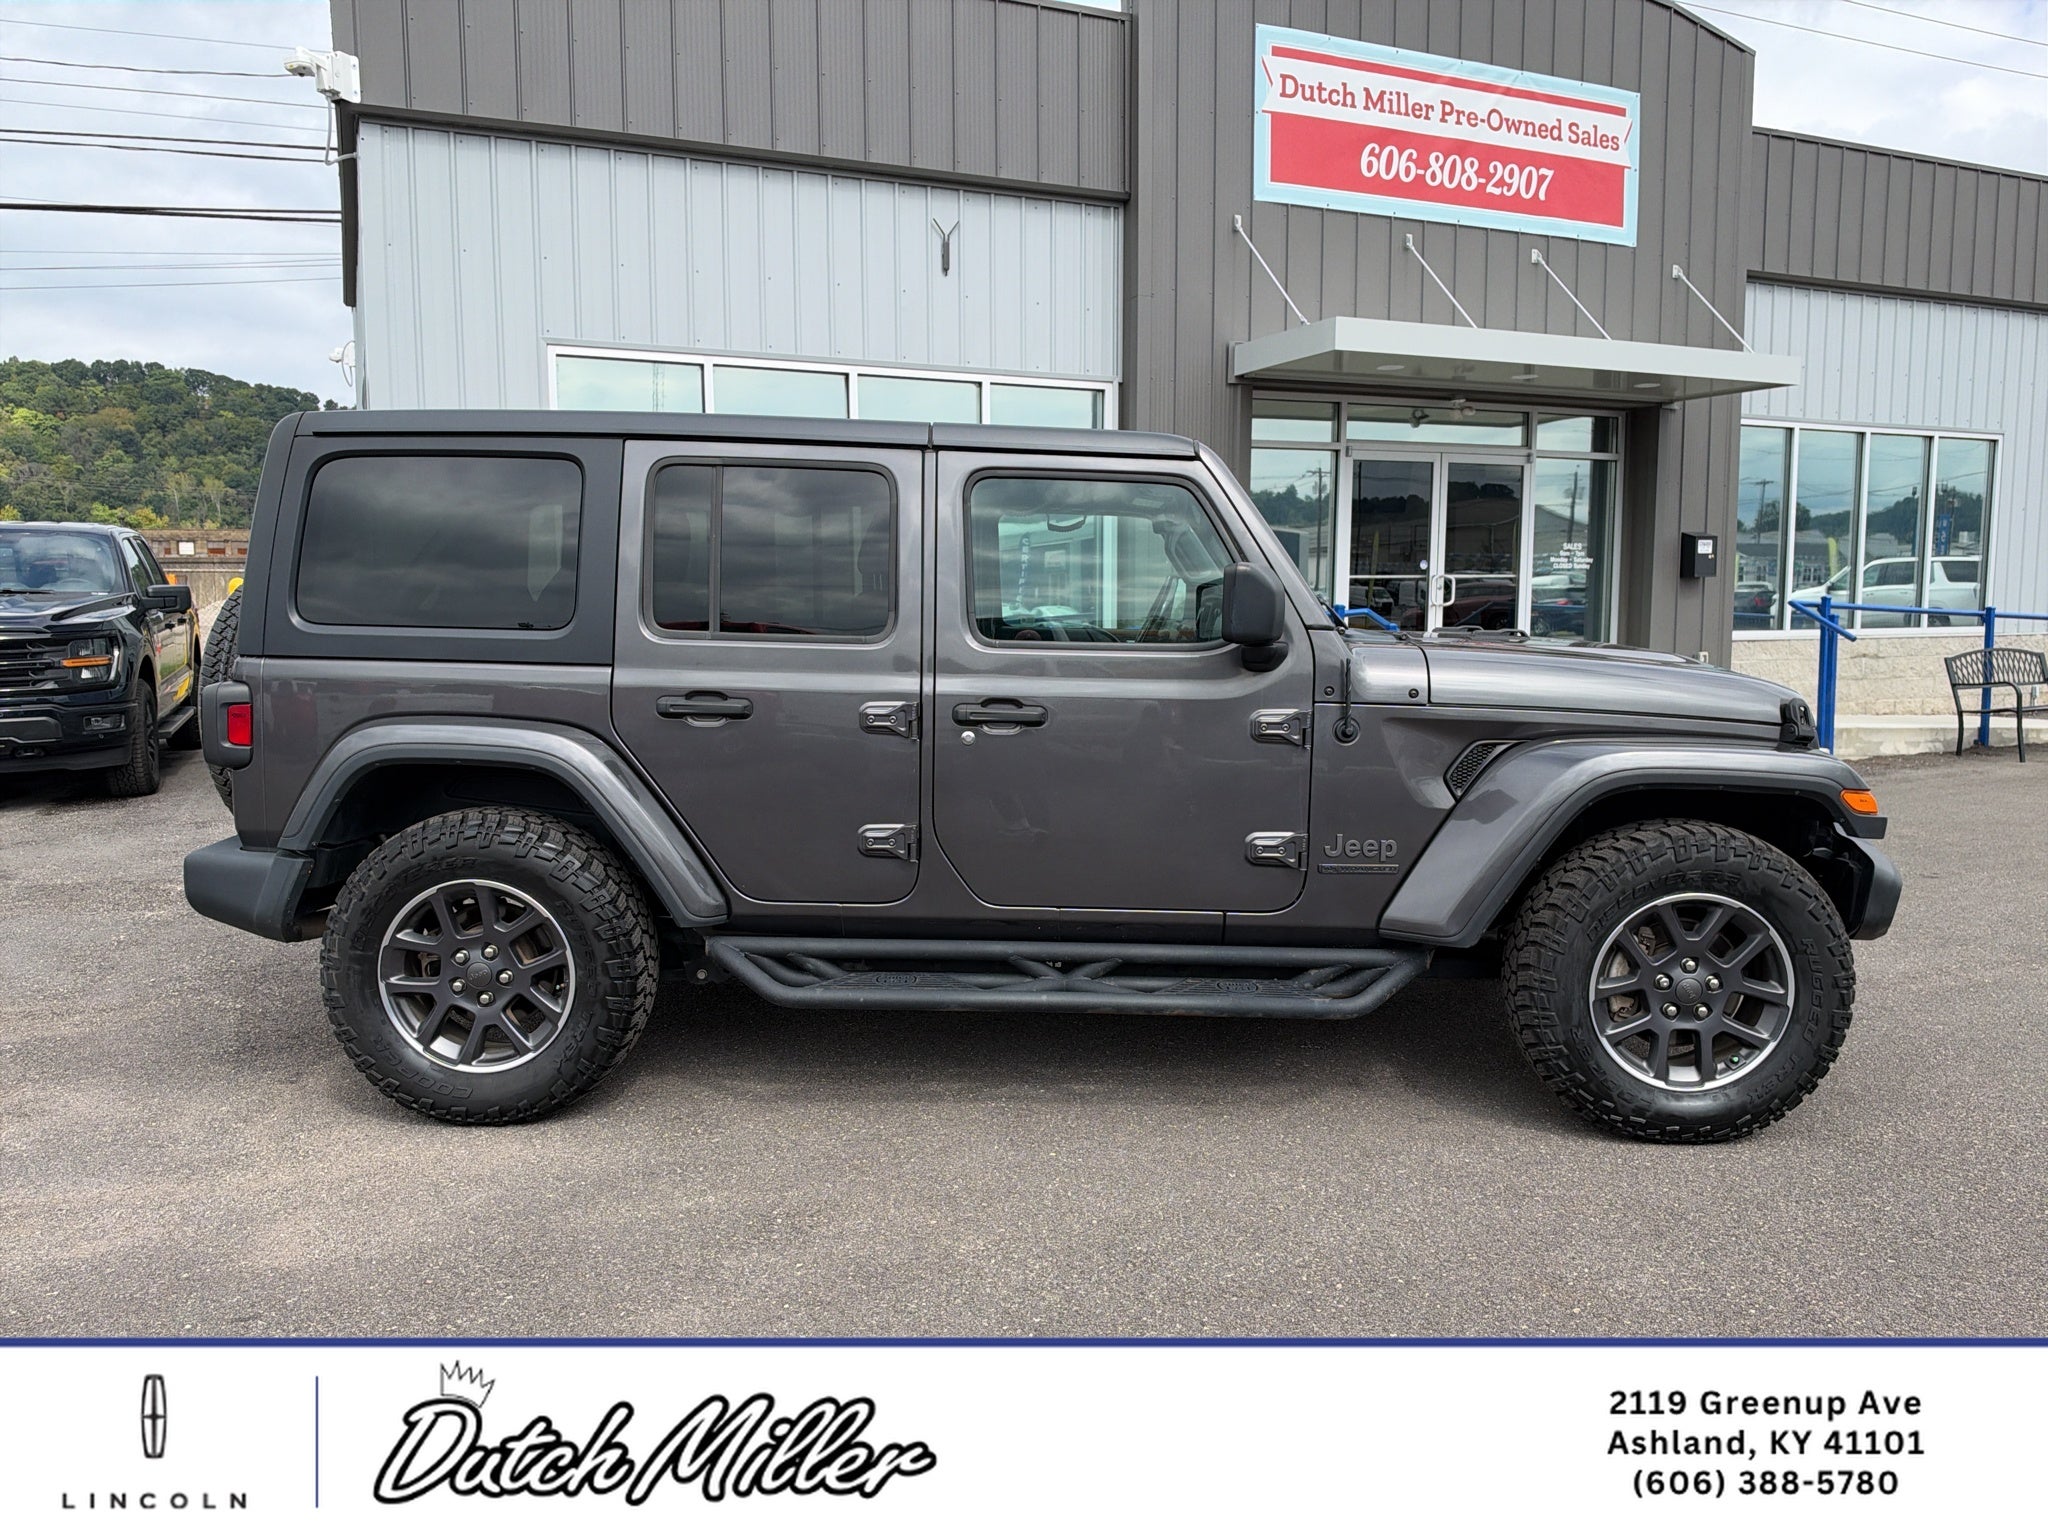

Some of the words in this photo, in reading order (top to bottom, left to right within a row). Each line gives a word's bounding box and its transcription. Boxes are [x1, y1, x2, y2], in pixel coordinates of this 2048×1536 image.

[1279, 72, 1357, 106] Dutch
[1362, 86, 1435, 121] Miller
[1439, 99, 1563, 142] Pre-Owned
[1567, 122, 1620, 151] Sales
[1360, 141, 1555, 201] 606-808-2907
[1562, 542, 1582, 550] SALES
[1573, 556, 1593, 564] Saturday
[1573, 562, 1590, 570] Sunday
[1324, 833, 1398, 862] Jeep
